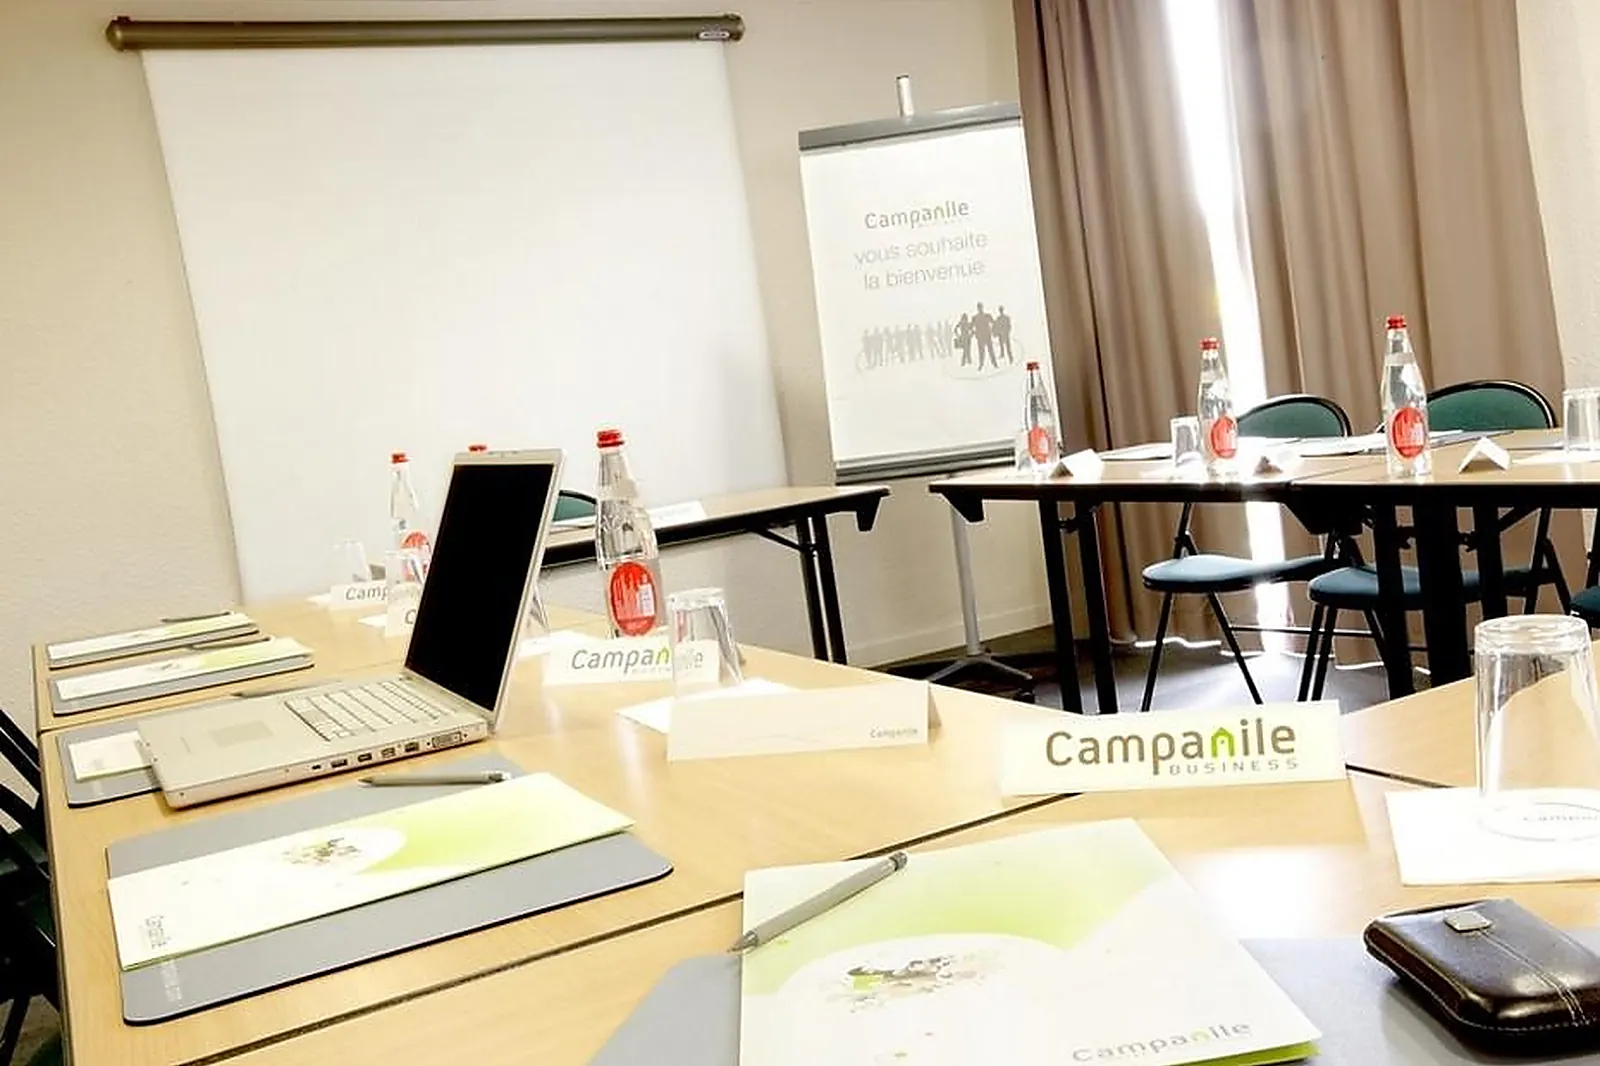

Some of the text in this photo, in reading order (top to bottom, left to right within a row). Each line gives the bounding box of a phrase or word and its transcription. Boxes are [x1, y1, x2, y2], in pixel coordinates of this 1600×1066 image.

[853, 231, 988, 265] vous souhaite
[864, 259, 985, 290] la bienvenue
[1046, 718, 1296, 775] Campanile
[1169, 758, 1299, 776] BUSINESS
